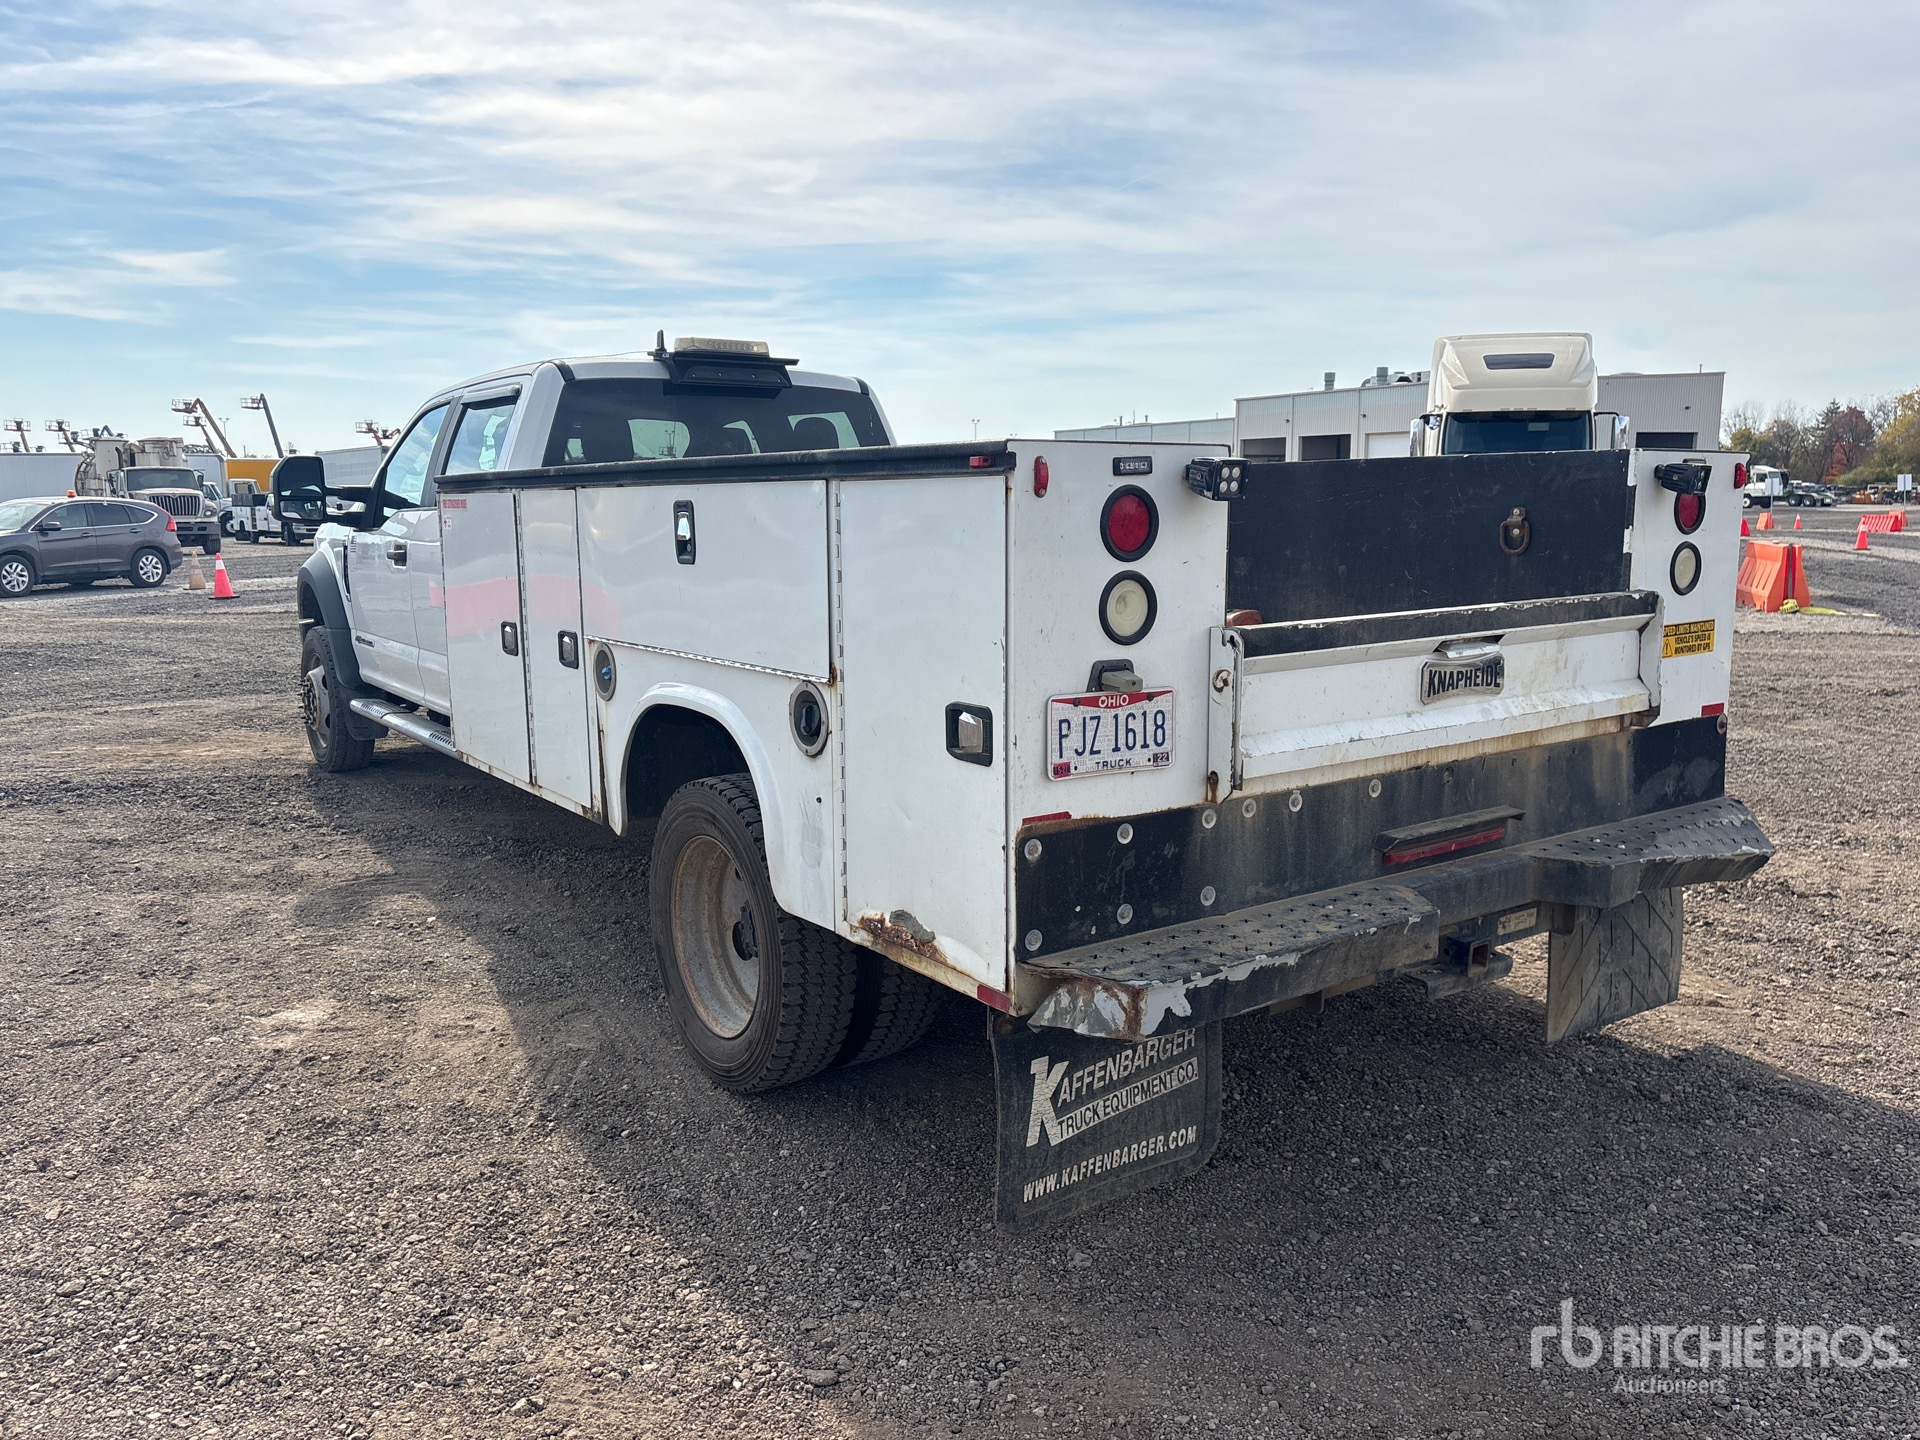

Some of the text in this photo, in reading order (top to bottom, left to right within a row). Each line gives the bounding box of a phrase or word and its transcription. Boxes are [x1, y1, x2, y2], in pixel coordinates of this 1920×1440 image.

[1703, 642, 1711, 651] GPS
[1428, 661, 1501, 698] KNAPHEIDE
[1099, 694, 1129, 708] OHIO
[1058, 709, 1166, 759] PJZ 1618
[1095, 758, 1132, 769] TRUCK
[1157, 752, 1168, 762] 22
[1057, 1062, 1198, 1140] TRUCK EQUIPMENT CO.
[1023, 1125, 1197, 1203] WWW.KAFFENBARGER.COM
